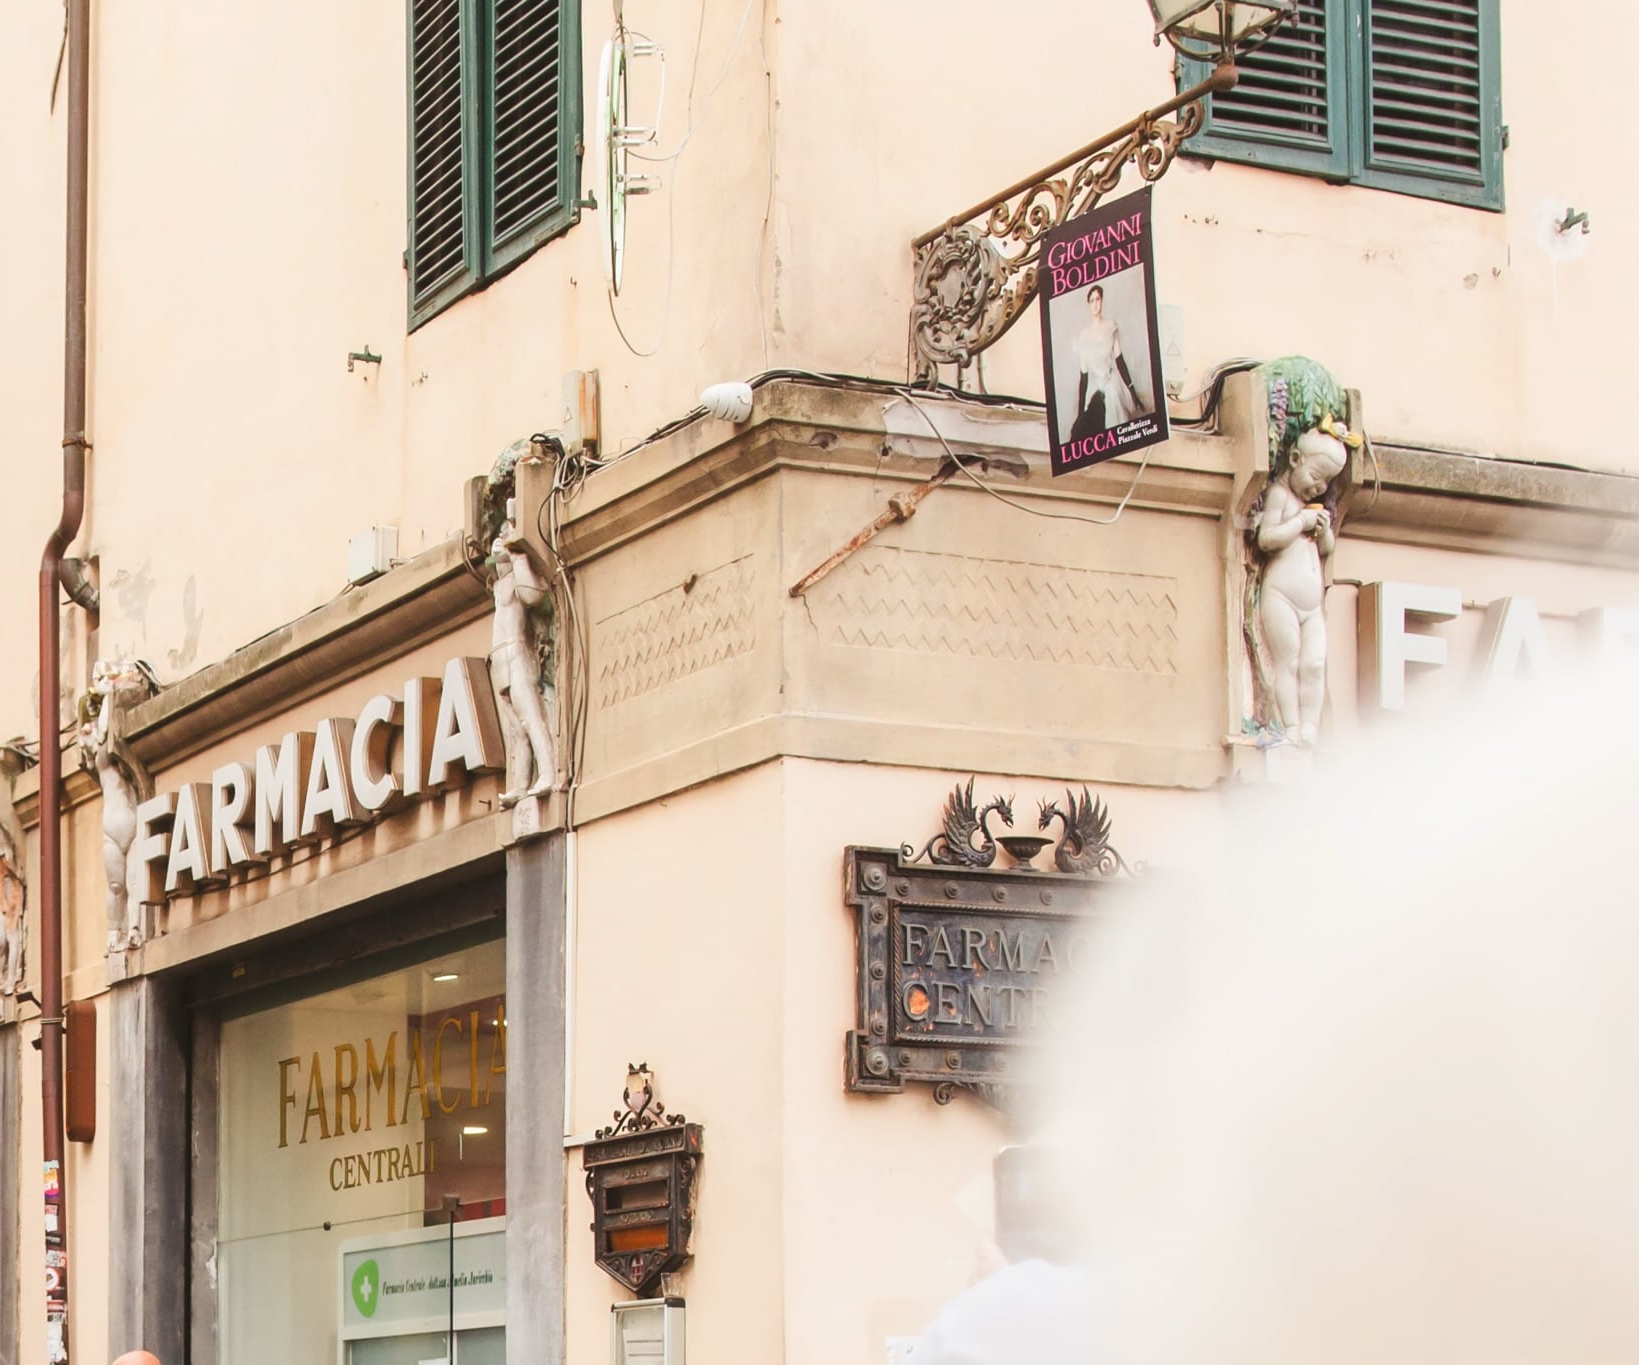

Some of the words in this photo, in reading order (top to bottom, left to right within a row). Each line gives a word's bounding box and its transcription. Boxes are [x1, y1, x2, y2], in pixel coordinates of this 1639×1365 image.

[1048, 213, 1142, 270] GIOVANNI
[1051, 241, 1141, 297] BOLDINI
[1061, 429, 1117, 464] LUCCA
[1118, 431, 1141, 445] Piazzale
[1141, 426, 1159, 441] Verdi
[1116, 418, 1151, 436] Cavallerizza
[136, 657, 496, 905] FARMACIA
[278, 1004, 506, 1148] FARMACIA
[330, 1137, 442, 1191] CENTRALE
